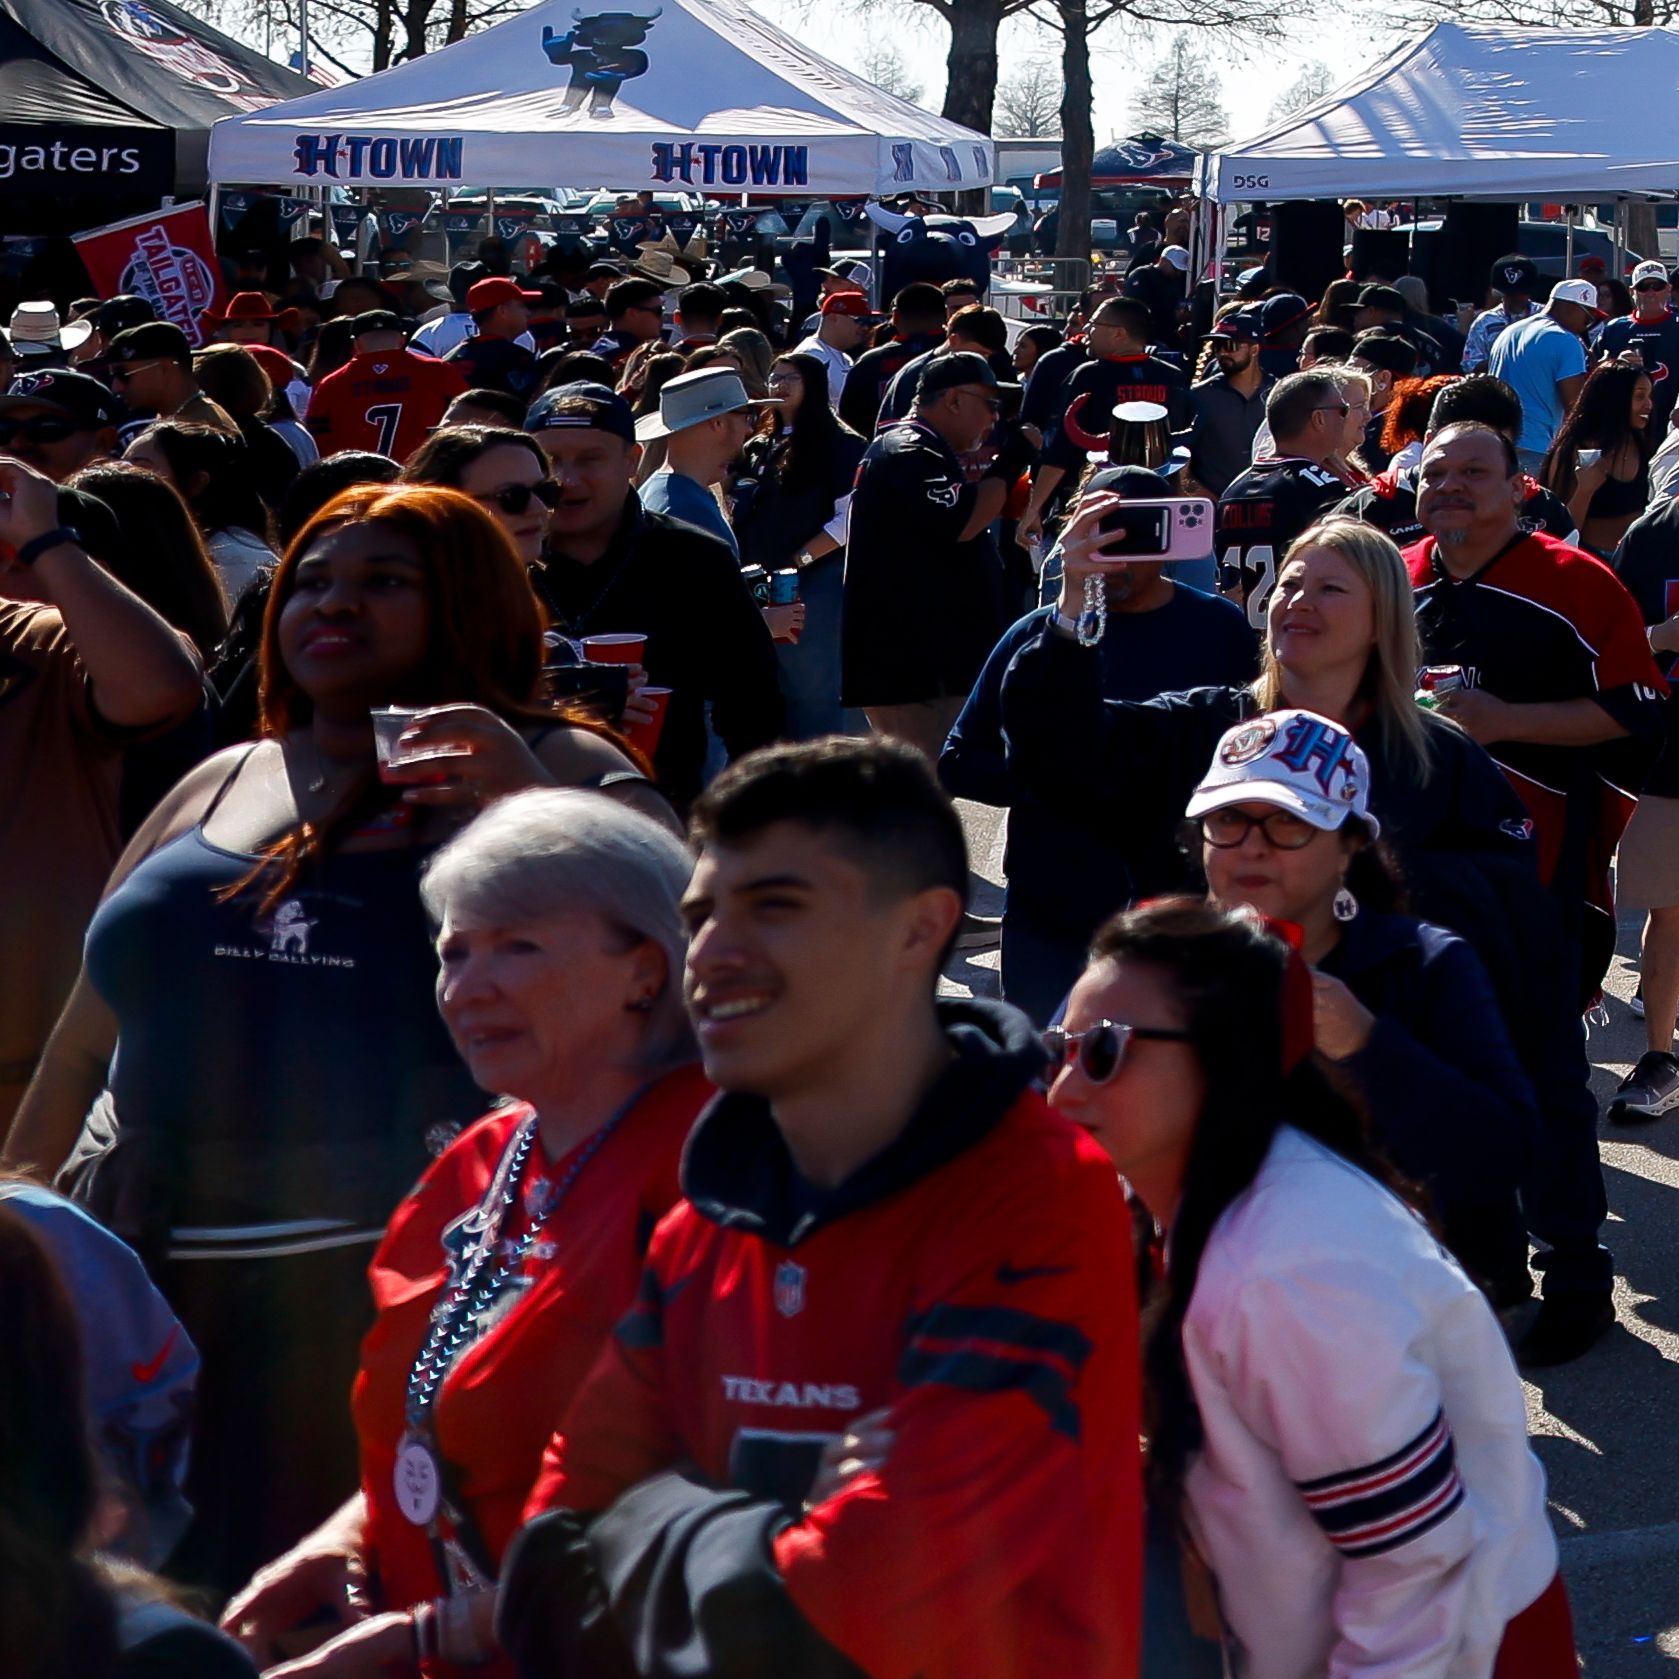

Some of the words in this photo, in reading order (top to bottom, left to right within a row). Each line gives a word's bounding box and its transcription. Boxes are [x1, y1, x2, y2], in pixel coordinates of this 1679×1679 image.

[1232, 174, 1271, 189] DSG
[1115, 382, 1169, 403] STROUD
[365, 403, 403, 457] 7
[722, 1374, 861, 1413] TEXANS
